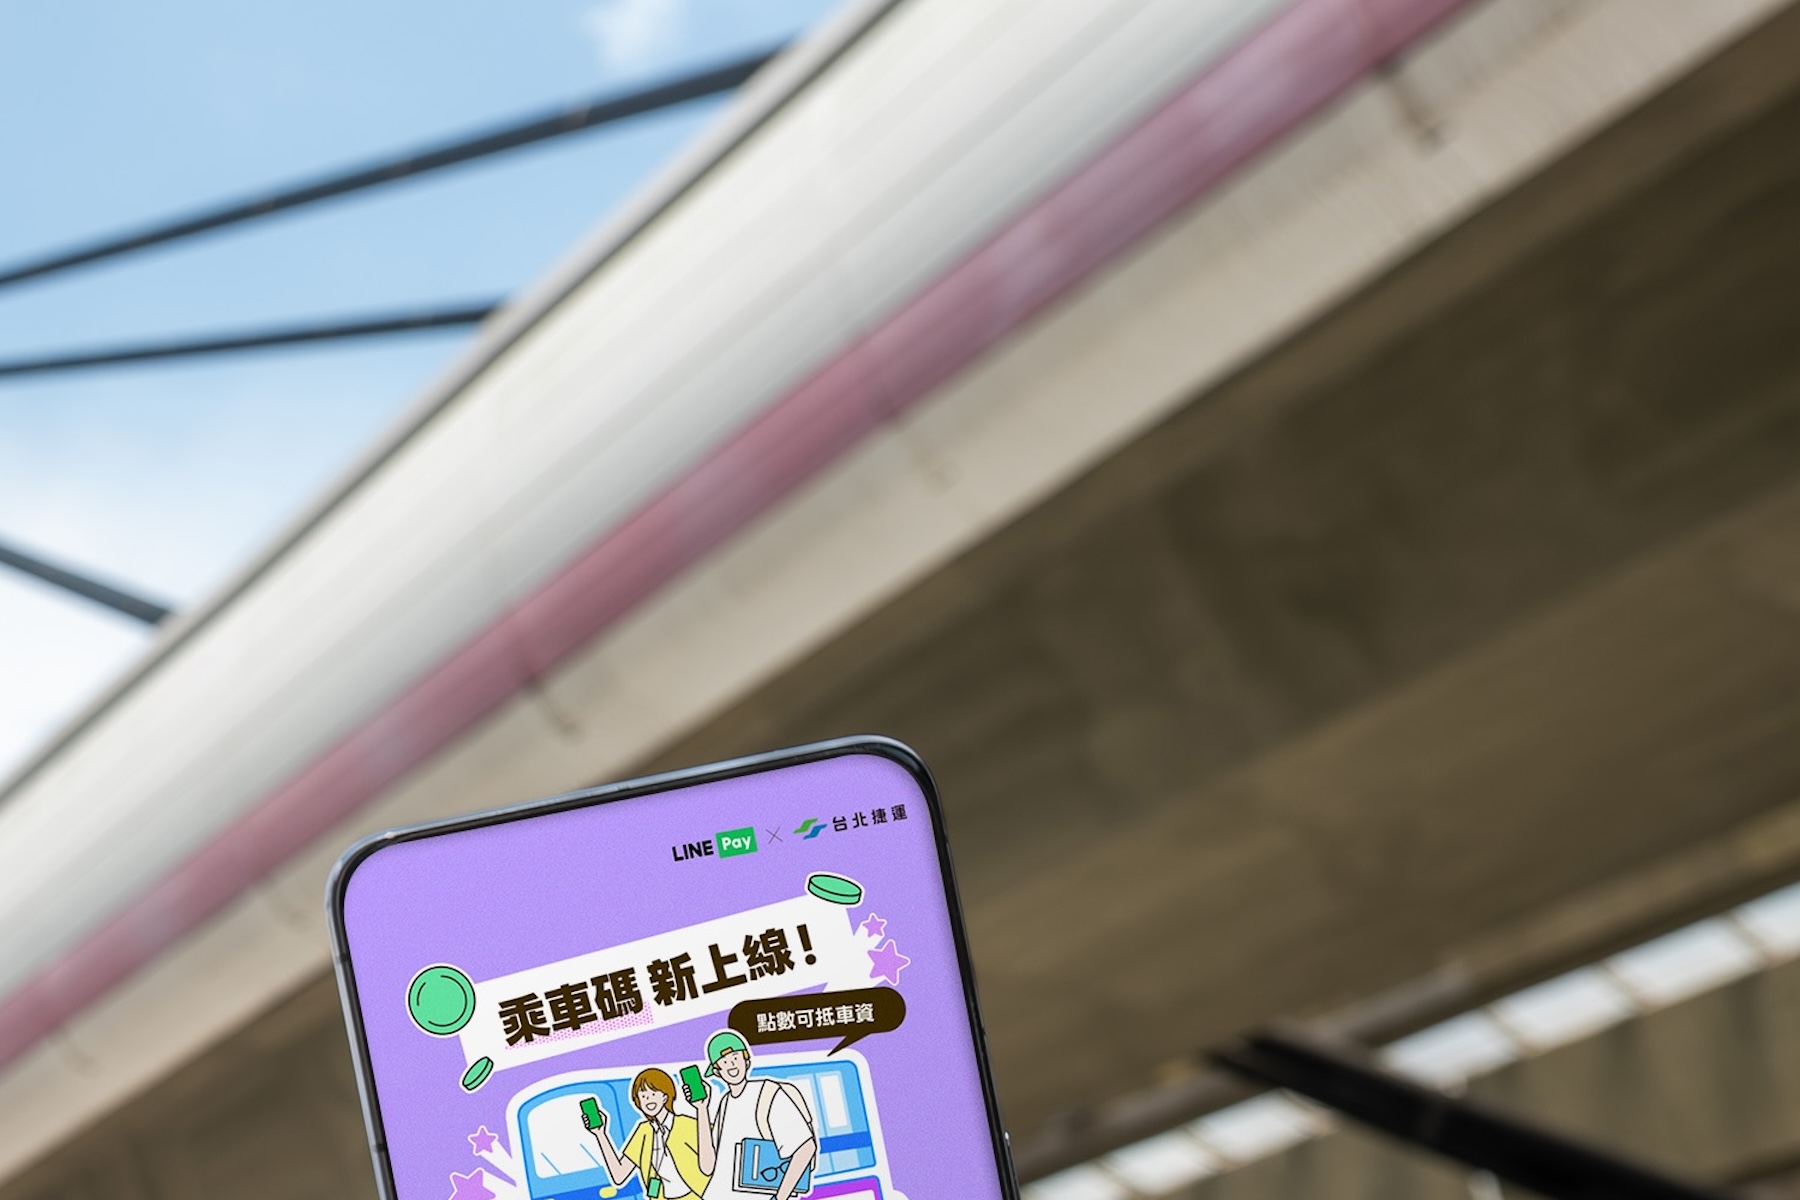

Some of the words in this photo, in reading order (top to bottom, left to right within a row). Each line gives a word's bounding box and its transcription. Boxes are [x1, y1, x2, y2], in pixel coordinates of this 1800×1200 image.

[832, 803, 908, 832] 台北捷運
[672, 840, 714, 862] LINE
[721, 835, 752, 851] Pay
[498, 967, 644, 1046] 乘車碼
[756, 1002, 875, 1034] 點數可抵車資
